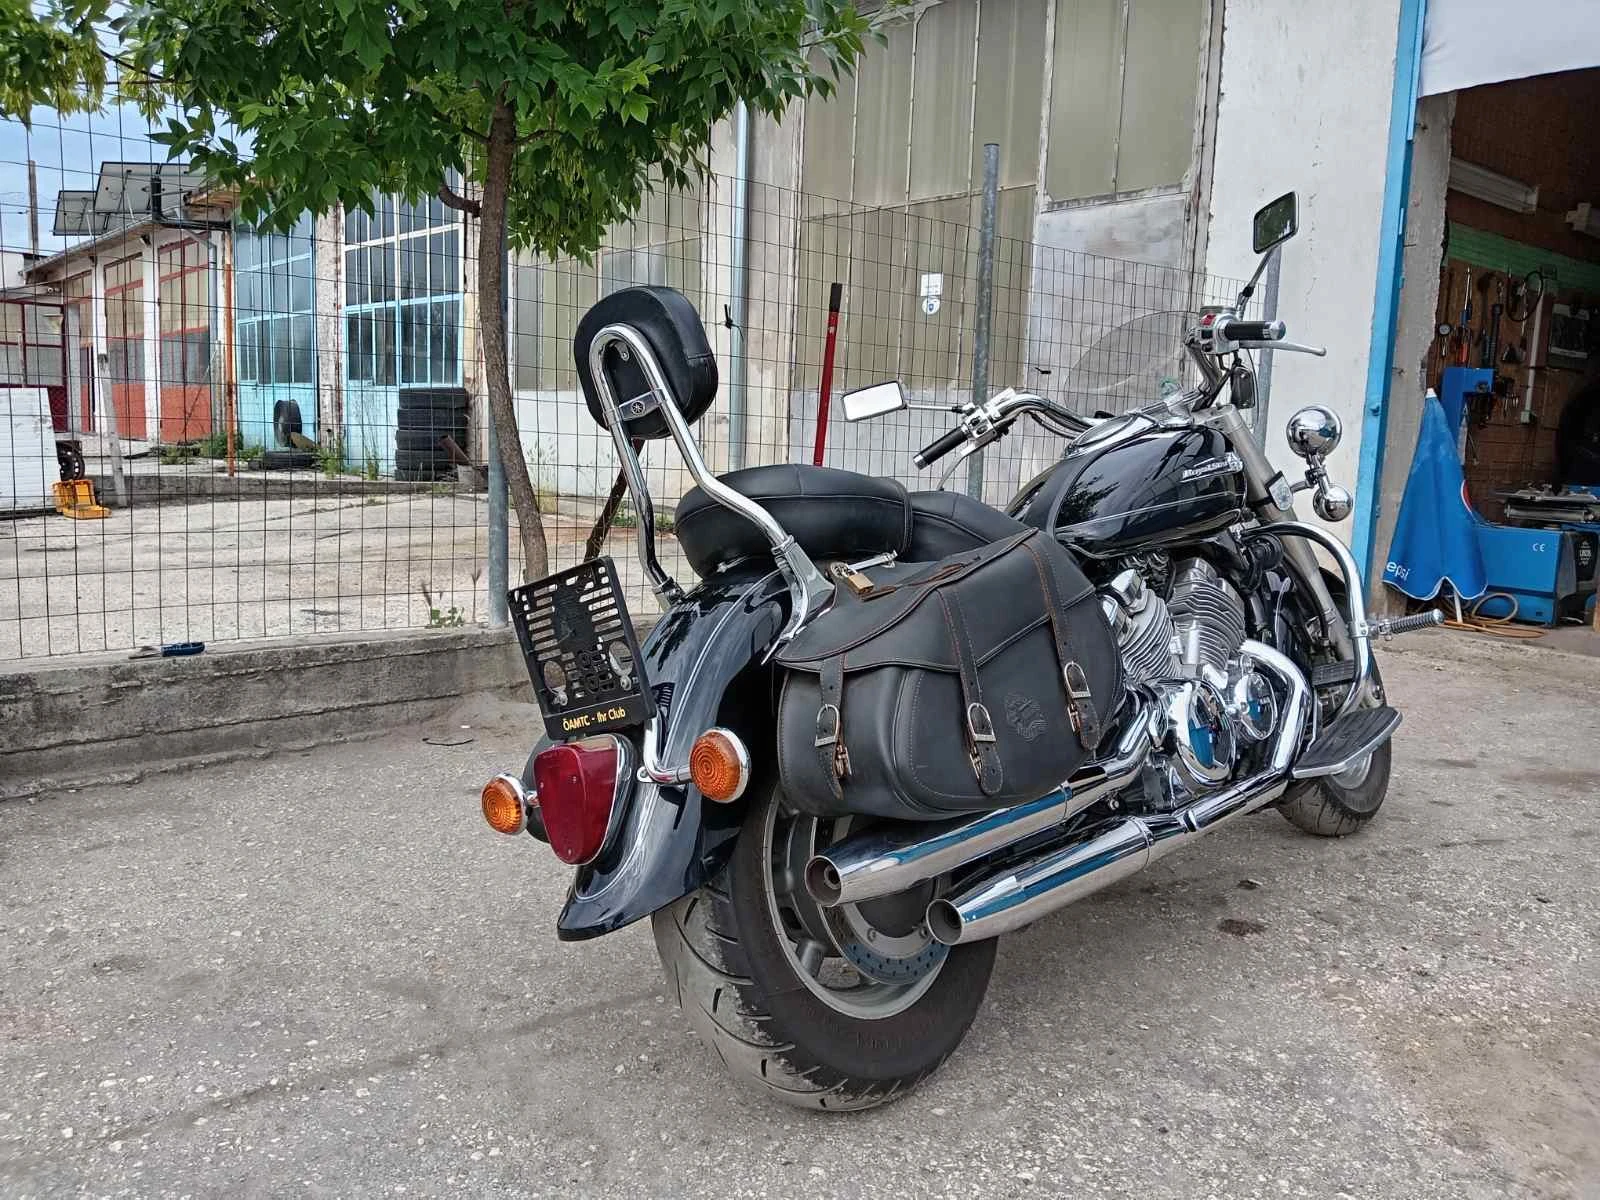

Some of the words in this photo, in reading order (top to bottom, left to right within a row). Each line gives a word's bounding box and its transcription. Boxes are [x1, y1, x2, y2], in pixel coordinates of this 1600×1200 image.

[562, 715, 591, 731] ÖAMTC
[597, 711, 607, 723] Ihr
[608, 706, 626, 720] Club
